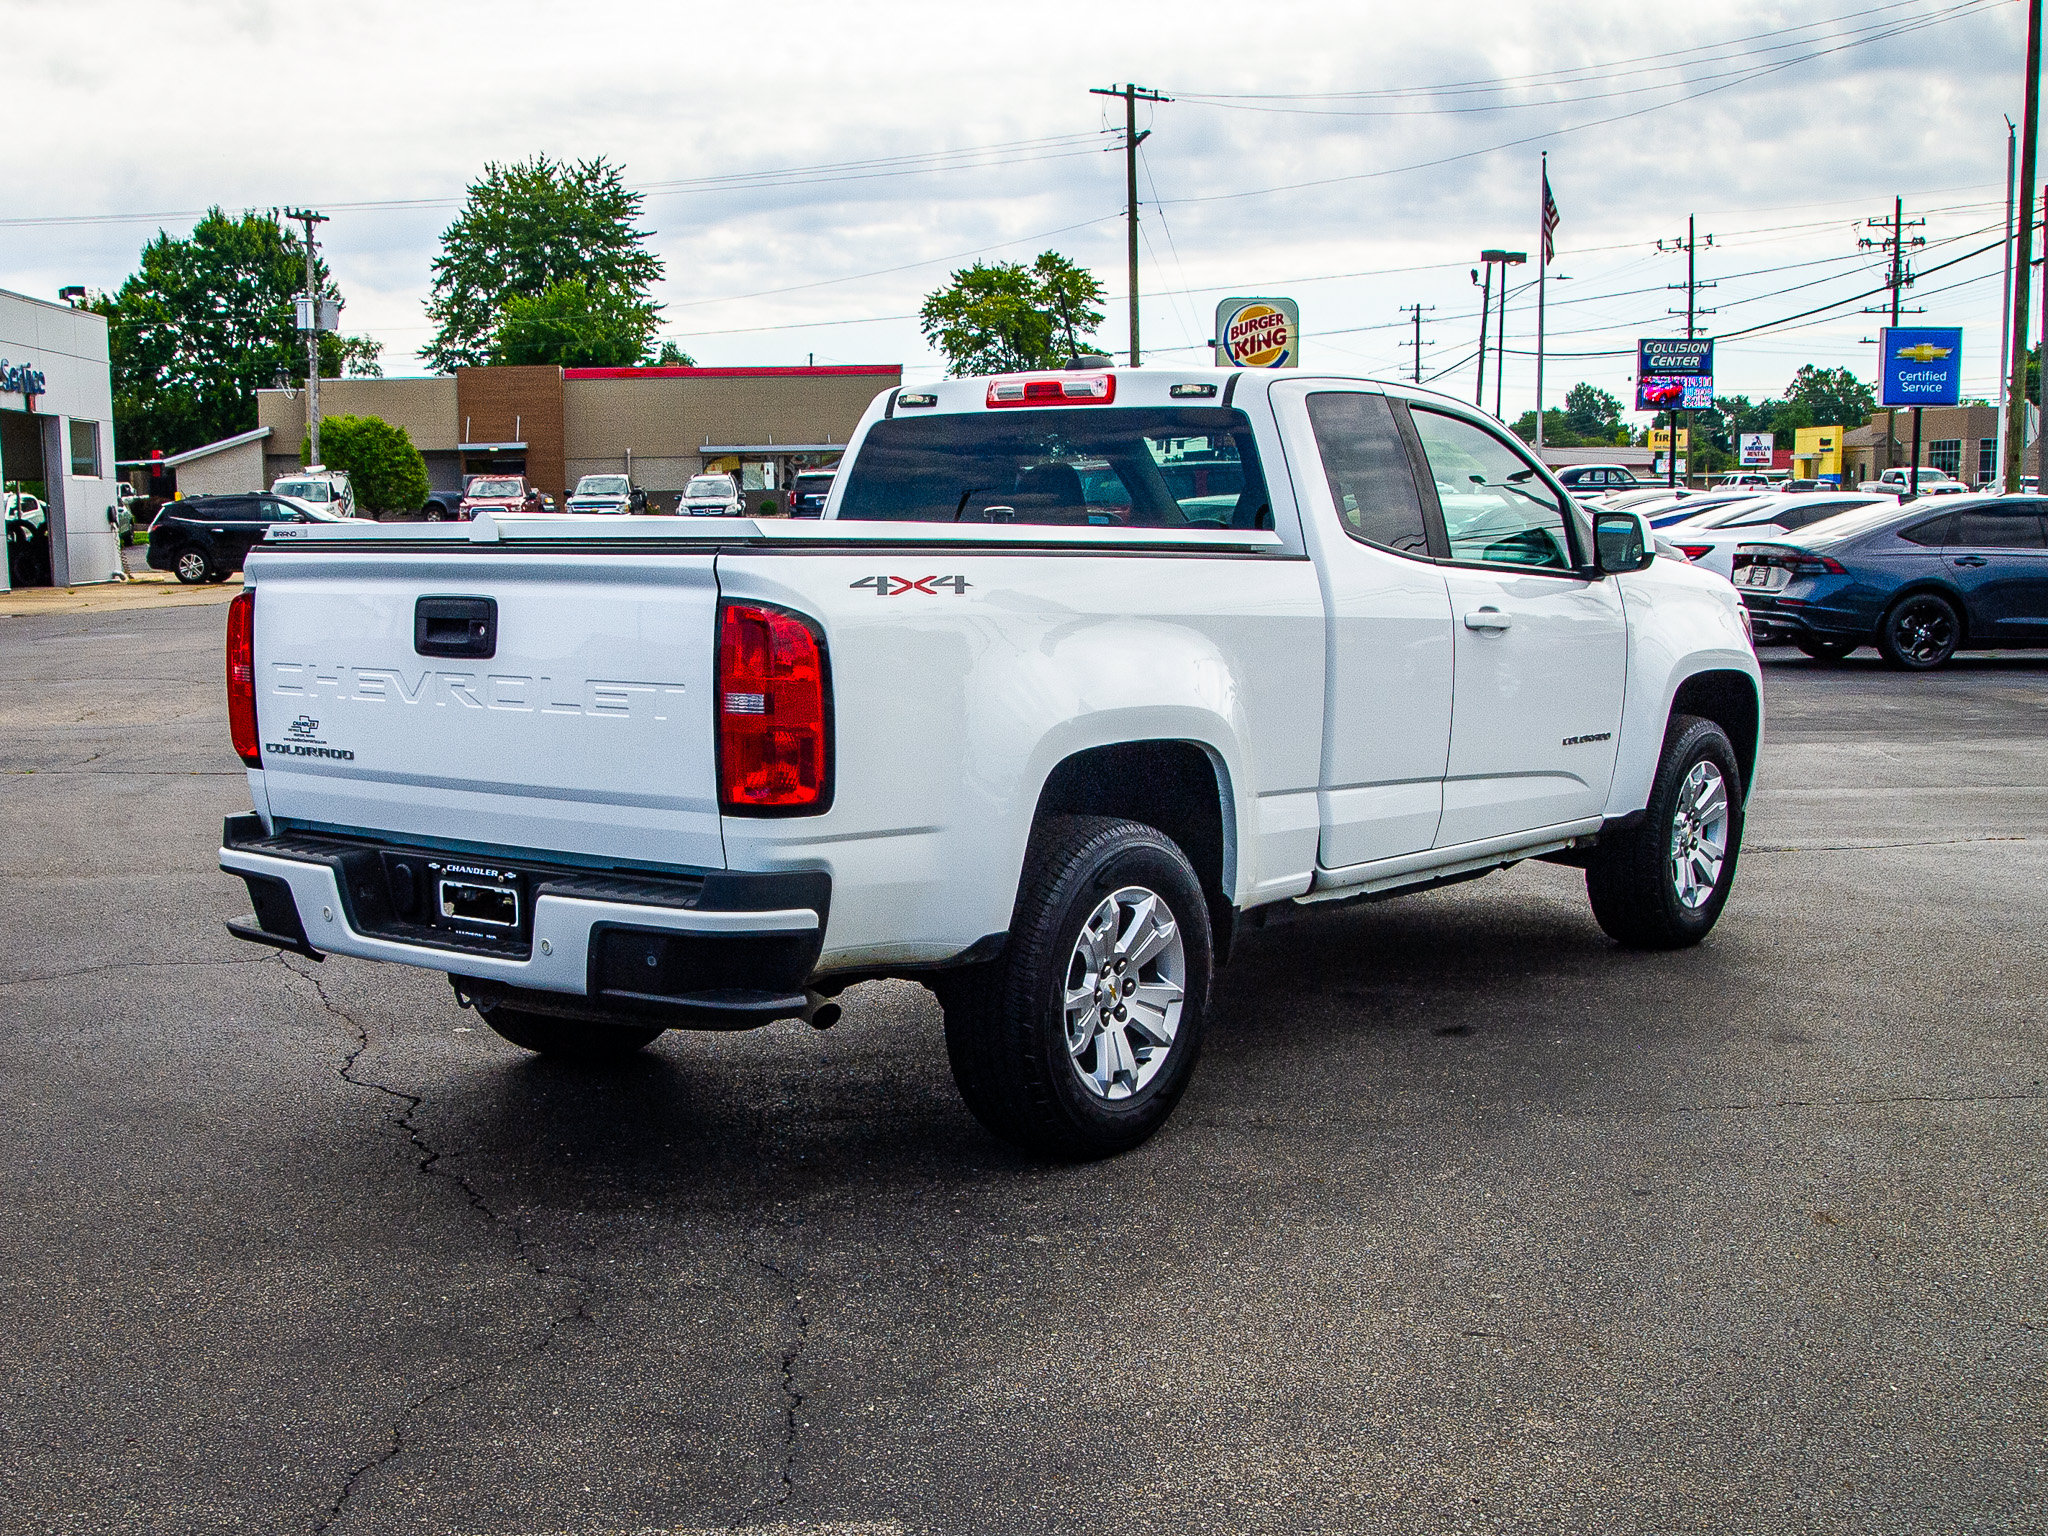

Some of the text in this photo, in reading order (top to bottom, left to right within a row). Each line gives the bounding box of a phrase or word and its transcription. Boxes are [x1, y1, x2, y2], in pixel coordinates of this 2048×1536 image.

[1231, 313, 1284, 341] BURGER
[1234, 328, 1287, 361] KING
[1644, 342, 1709, 354] COLLISION
[1650, 355, 1700, 366] CENTER
[0, 358, 46, 394] Service
[1898, 370, 1947, 382] Certified
[1901, 382, 1943, 393] Service
[272, 662, 685, 721] CHEVROLET
[1562, 732, 1612, 746] COLORADO
[265, 742, 355, 761] COLORADO
[446, 864, 499, 877] CHANDLER
